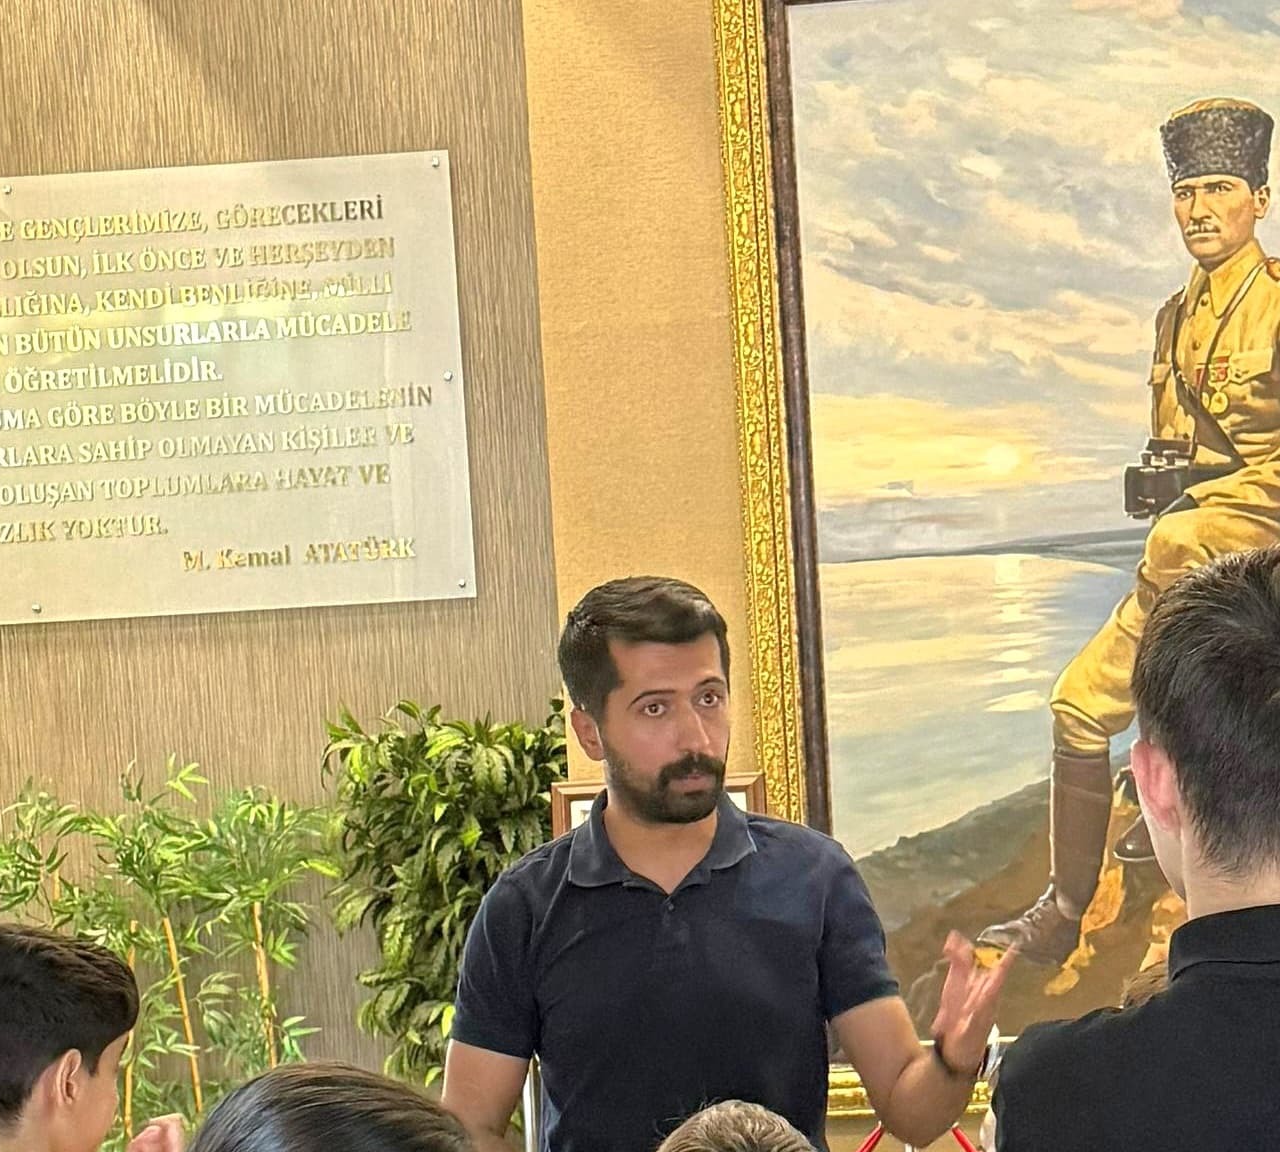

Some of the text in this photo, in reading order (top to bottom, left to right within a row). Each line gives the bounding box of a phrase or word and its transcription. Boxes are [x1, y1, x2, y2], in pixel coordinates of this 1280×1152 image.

[20, 208, 209, 243] GENÇLERİMİZE,
[216, 194, 384, 229] GÖRECEKLERİ
[0, 252, 88, 281] OLSUN,
[92, 249, 133, 275] İLK
[139, 244, 206, 272] ÖNCE
[215, 246, 244, 268] VE
[247, 236, 394, 269] HERŞEYDEN
[95, 281, 173, 313] KENDİ
[14, 325, 101, 356] BÜTÜN
[106, 319, 270, 349] UNSURLARLA
[275, 310, 412, 340] MÜCADELE
[4, 355, 224, 394] ÖĞRETİLMELİDİR.
[47, 400, 114, 428] GÖRE
[120, 396, 201, 424] BÖYLE
[206, 392, 249, 419] BİR
[254, 383, 433, 415] MÜCADELENİN
[79, 436, 153, 462] SAHİP
[158, 431, 275, 459] OLMAYAN
[281, 424, 378, 454] KİŞİLER
[385, 423, 414, 445] VE
[100, 469, 268, 500] TOPLUMLARA
[276, 465, 350, 490] HAYAT
[358, 464, 390, 485] VE
[62, 513, 169, 541] YOKTUR.
[183, 536, 416, 571] M. Kemal ATATÜRK
